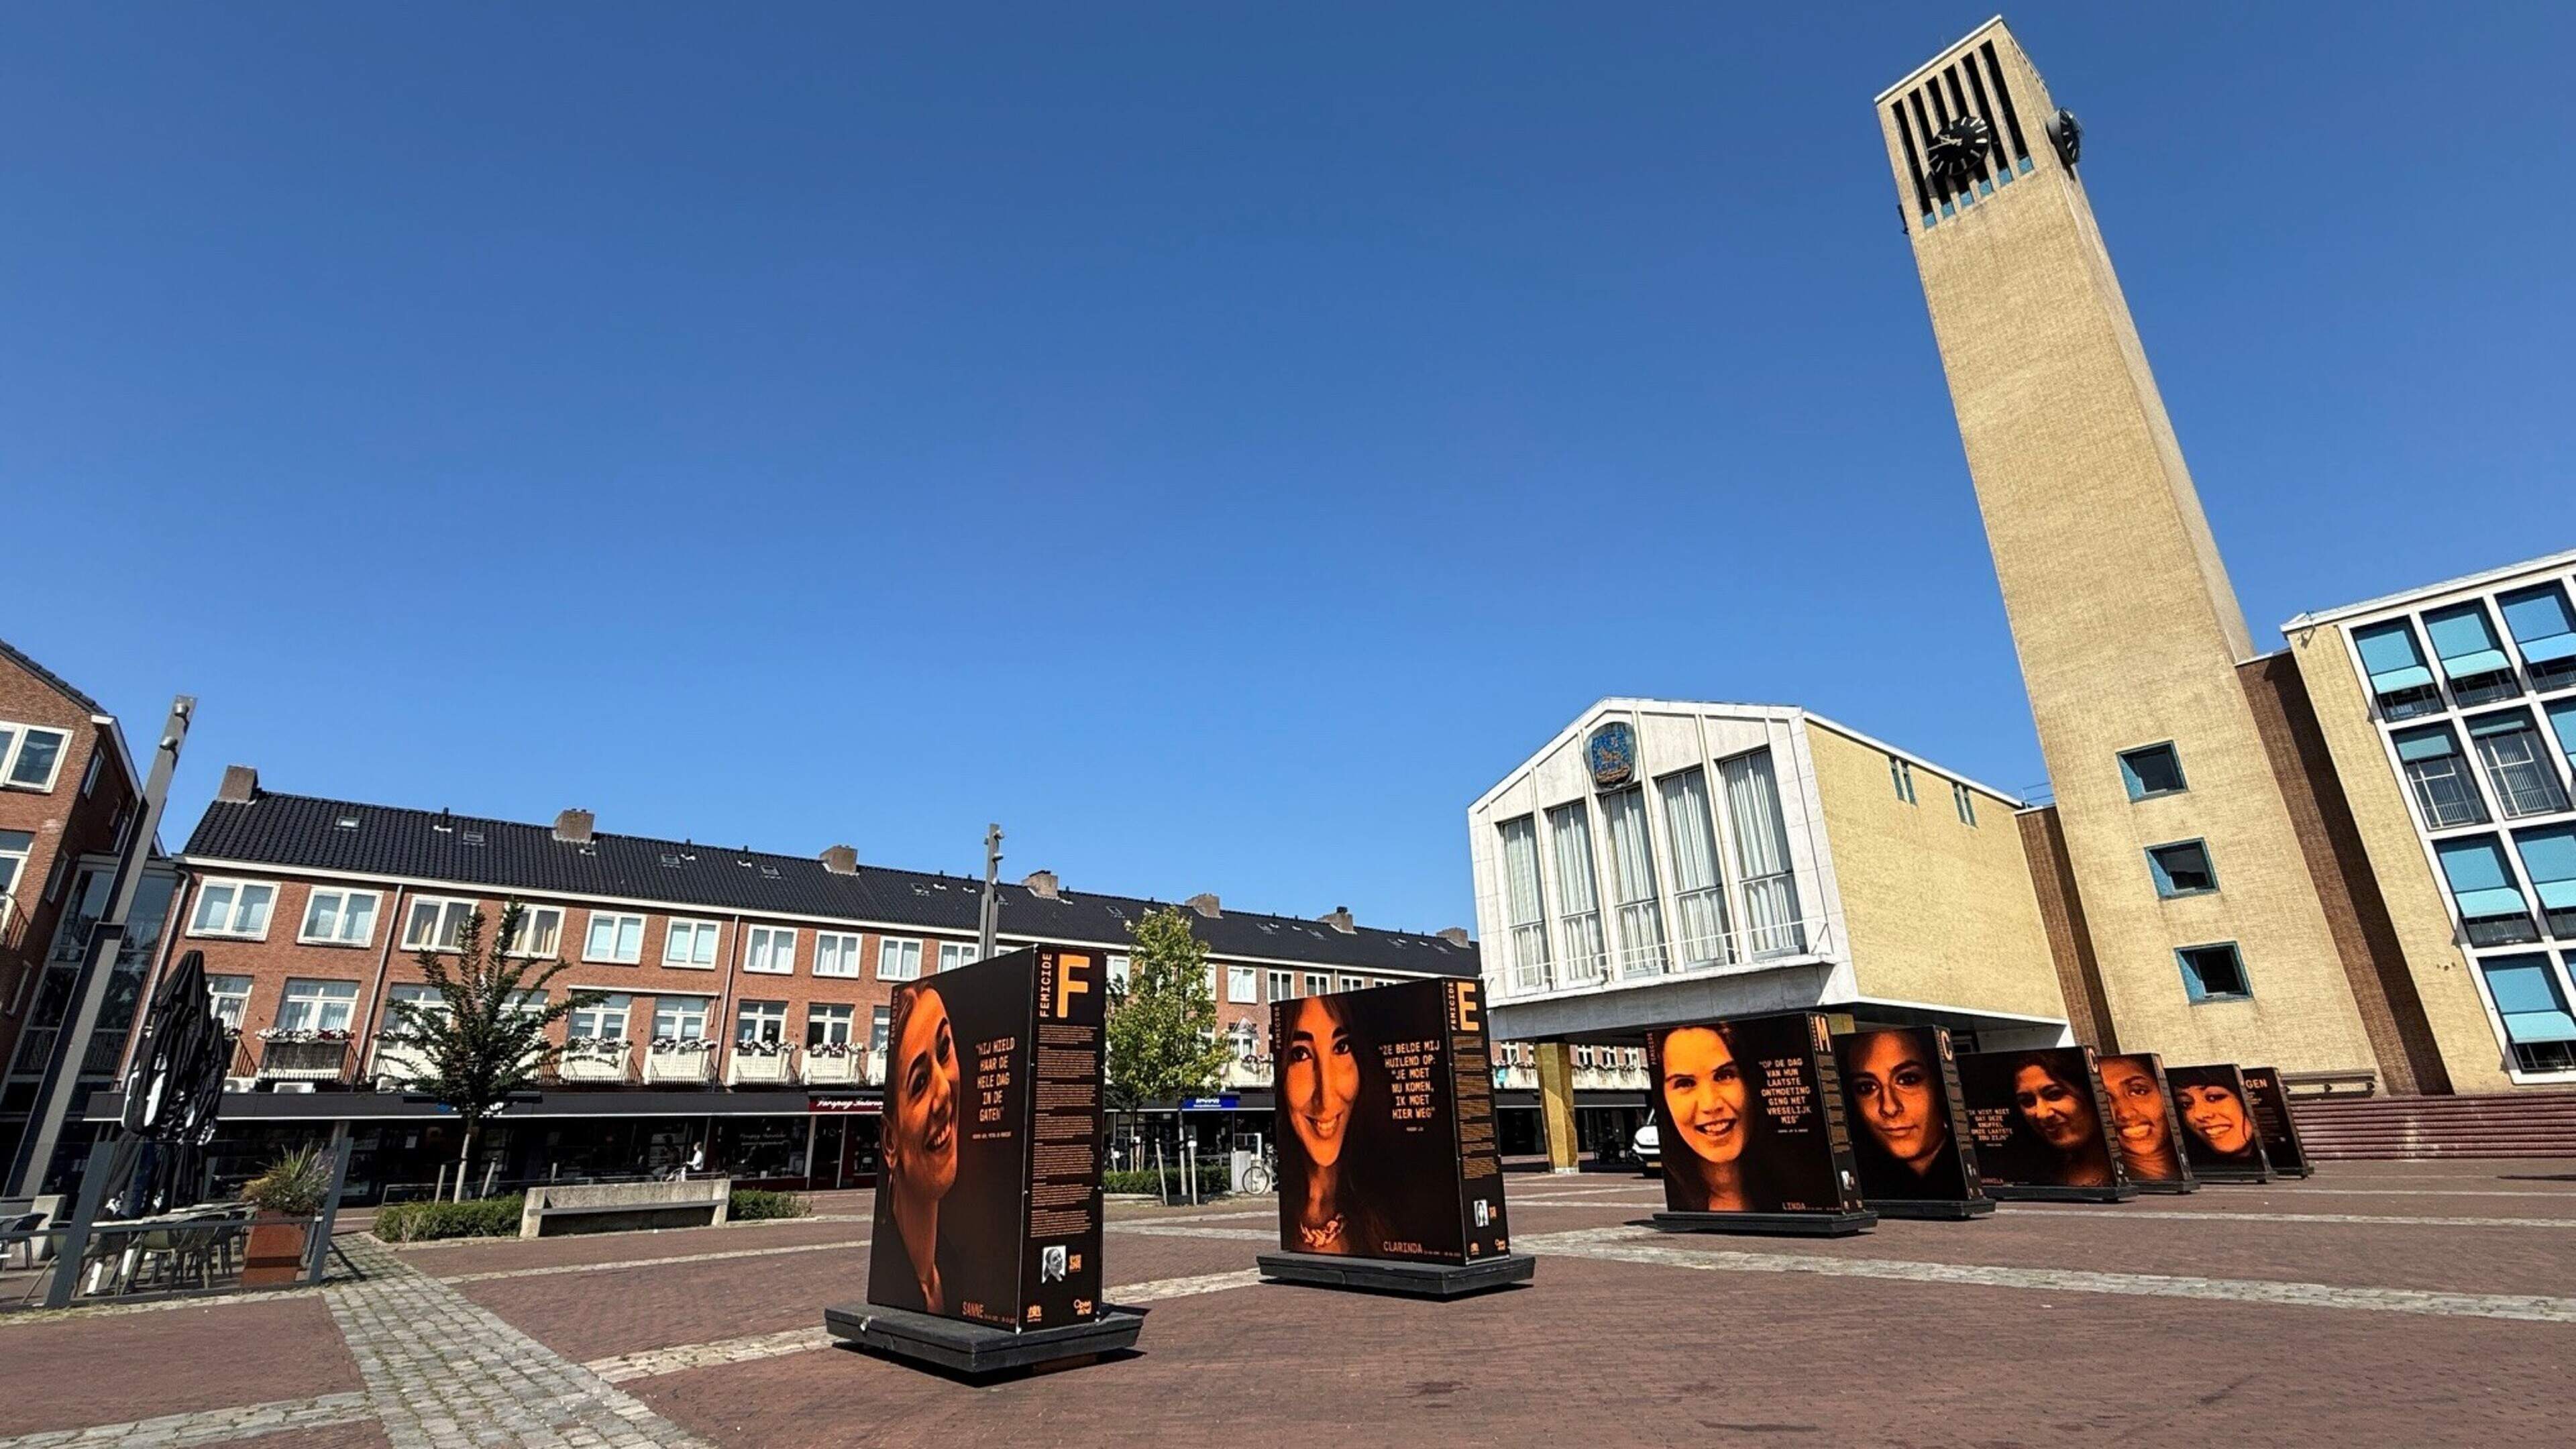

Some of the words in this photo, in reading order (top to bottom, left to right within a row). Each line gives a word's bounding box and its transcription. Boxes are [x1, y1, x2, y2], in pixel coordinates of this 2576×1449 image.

[1039, 953, 1052, 1018] FEMICIDE
[1057, 953, 1090, 1018] F
[1448, 982, 1457, 1031] FEMICIDE
[1457, 981, 1479, 1031] E
[1815, 1014, 1831, 1052] M
[993, 1037, 1015, 1053] HIELD
[1395, 1042, 1421, 1054] BELDE
[1424, 1040, 1440, 1051] MIJ
[1941, 1030, 1953, 1061] C
[980, 1057, 997, 1071] HAAR
[999, 1055, 1009, 1069] DE
[1385, 1055, 1420, 1069] HUILEND
[1774, 1059, 1785, 1067] DE
[1787, 1057, 1803, 1067] DAG
[2088, 1048, 2098, 1073] C
[1409, 1067, 1430, 1079] MOET
[1766, 1069, 1781, 1078] VAN
[1783, 1067, 1799, 1076] HUN
[977, 1075, 994, 1089] HELE
[996, 1072, 1010, 1086] DAG
[1766, 1077, 1801, 1087] LAATSTE
[2245, 1079, 2267, 1089] GEN
[1391, 1083, 1403, 1093] NU
[1761, 1086, 1811, 1097] ONTMOETING
[983, 1091, 991, 1105] IN
[994, 1089, 1004, 1104] DE
[1395, 1095, 1406, 1106] IK
[1409, 1094, 1430, 1106] MOET
[1768, 1097, 1788, 1106] GING
[1392, 1108, 1413, 1120] HIER
[1766, 1106, 1811, 1116] VRESELIJK
[1782, 1201, 1806, 1210] LINDA
[1383, 1241, 1423, 1254] CLARINDA
[962, 1301, 984, 1319] SANNE
